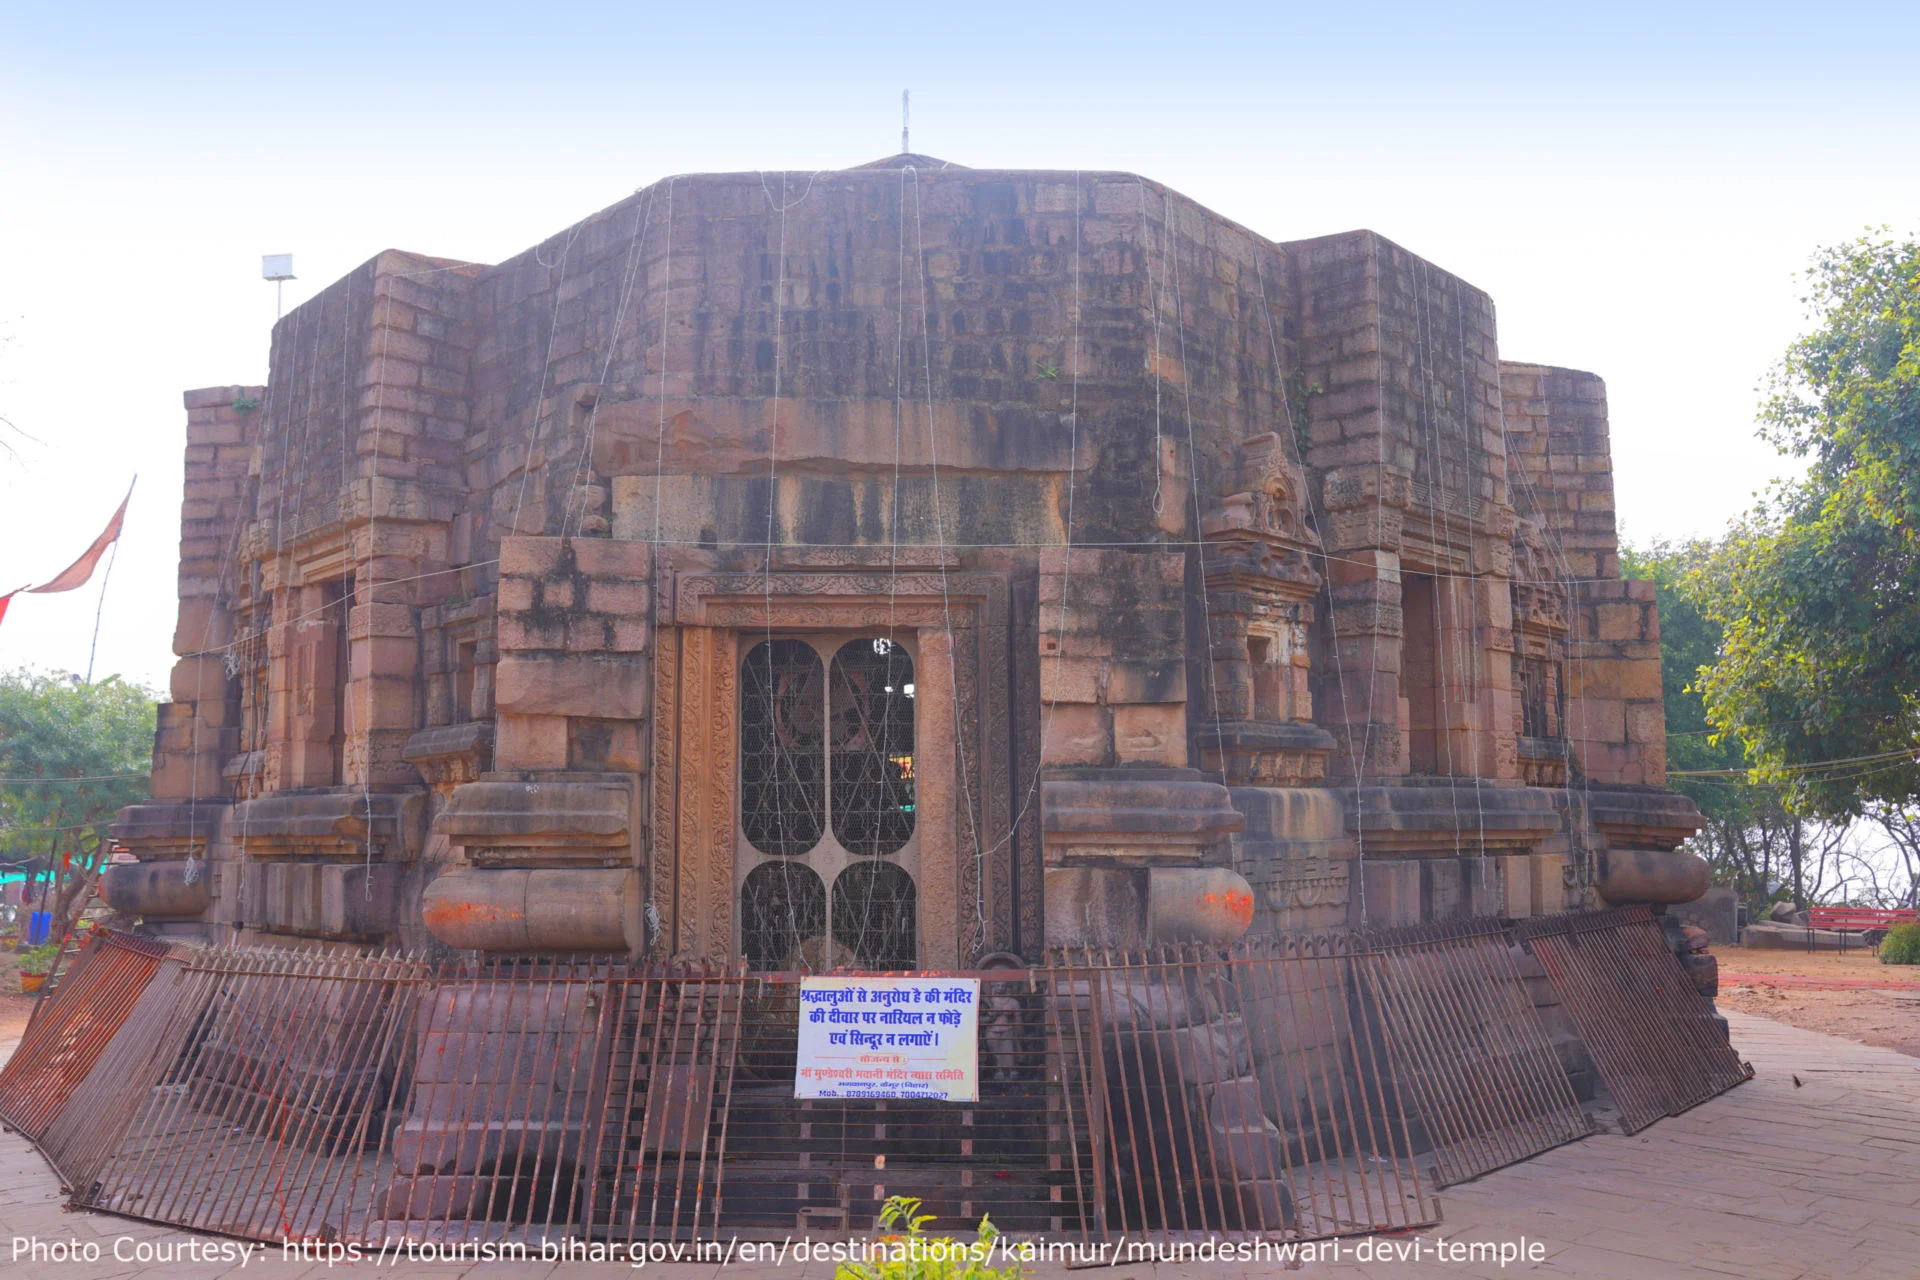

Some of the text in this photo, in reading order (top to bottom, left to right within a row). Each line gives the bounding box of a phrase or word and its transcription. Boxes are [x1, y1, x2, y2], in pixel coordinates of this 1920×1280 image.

[801, 988, 856, 1006] श्रद्धालुओं
[857, 988, 867, 1002] से
[914, 988, 922, 1003] है
[925, 990, 940, 1003] की
[944, 988, 972, 1003] मंदिर
[810, 1008, 962, 1028] की दीवार पर नारियल न फोड़े
[830, 1029, 846, 1045] एवं
[850, 1030, 882, 1050] सिन्दूर
[886, 1034, 895, 1046] न
[886, 1069, 907, 1080] मंदिर
[935, 1069, 964, 1080] समिति
